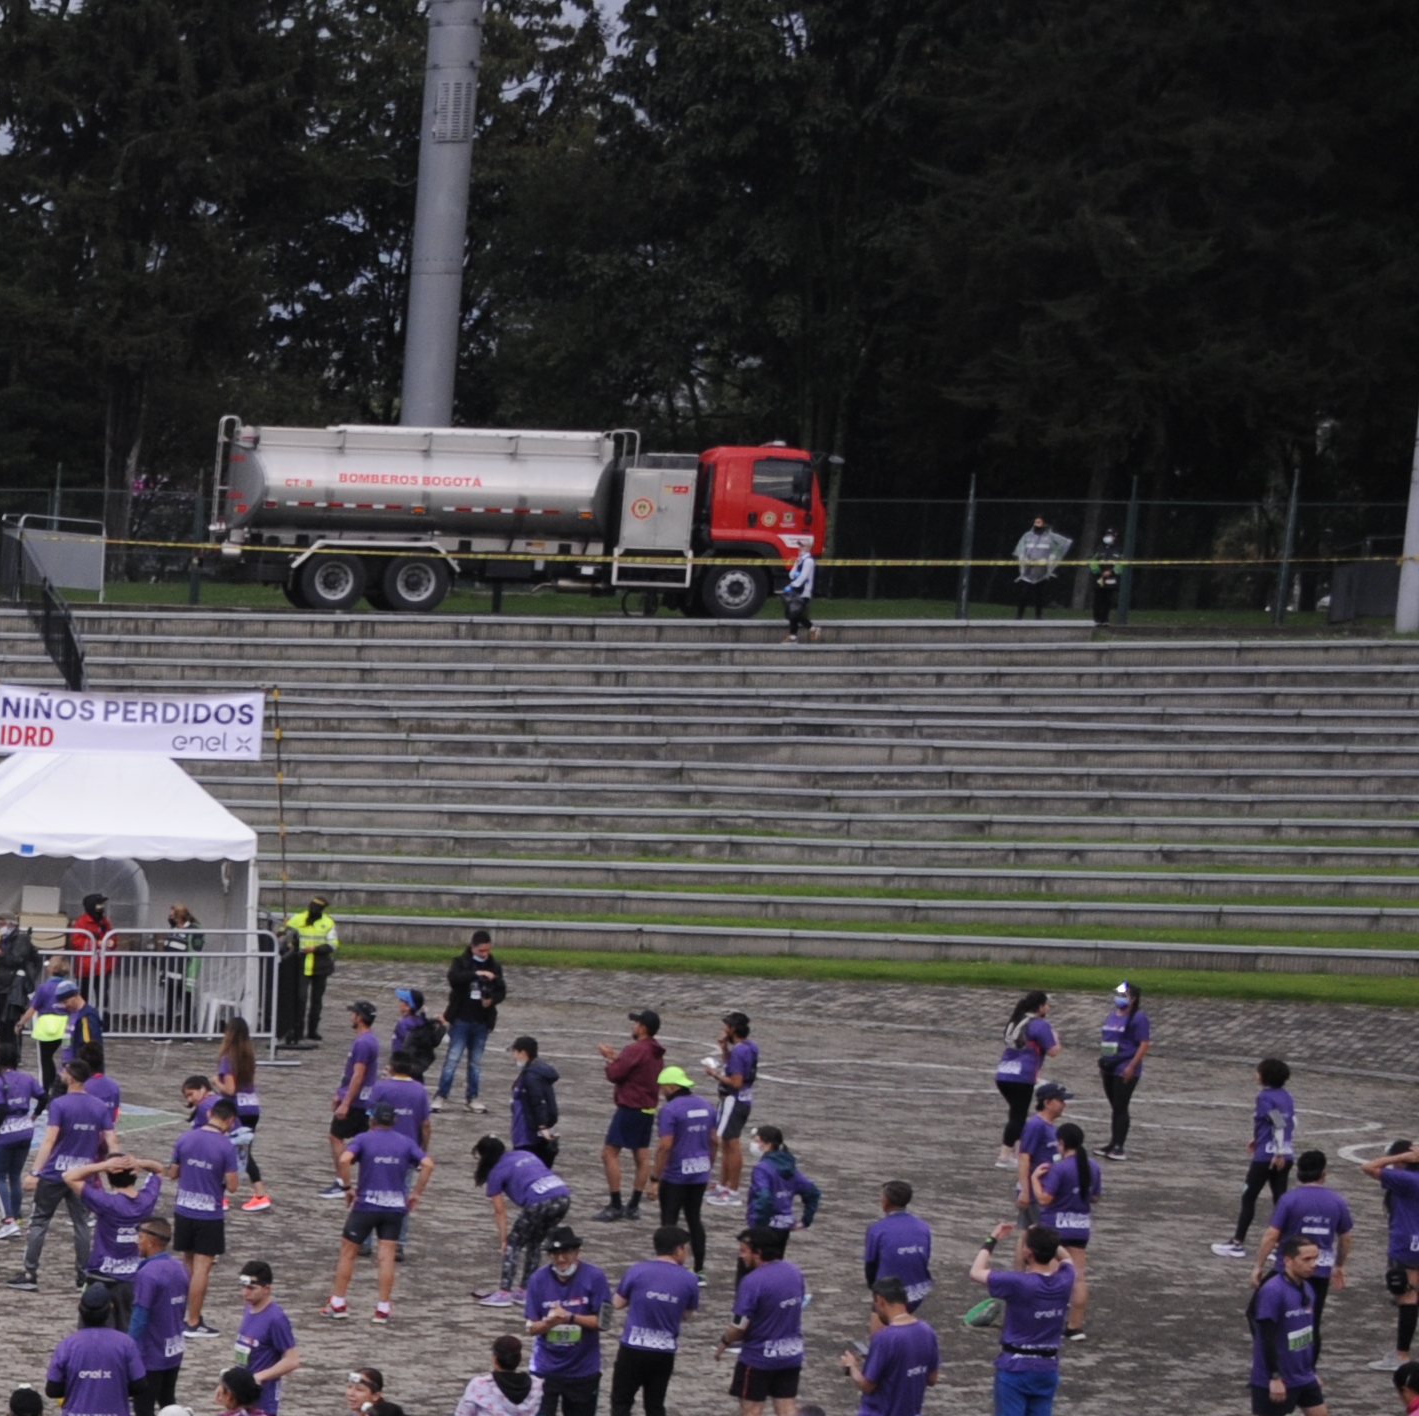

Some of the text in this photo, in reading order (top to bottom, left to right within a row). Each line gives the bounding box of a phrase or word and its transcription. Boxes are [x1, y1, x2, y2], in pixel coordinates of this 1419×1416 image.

[338, 472, 419, 486] BOMBEROS
[1, 692, 254, 725] NIÑOS PERDIDOS
[0, 725, 54, 747] IDRD
[172, 732, 227, 752] enel
[78, 1370, 102, 1378] enel
